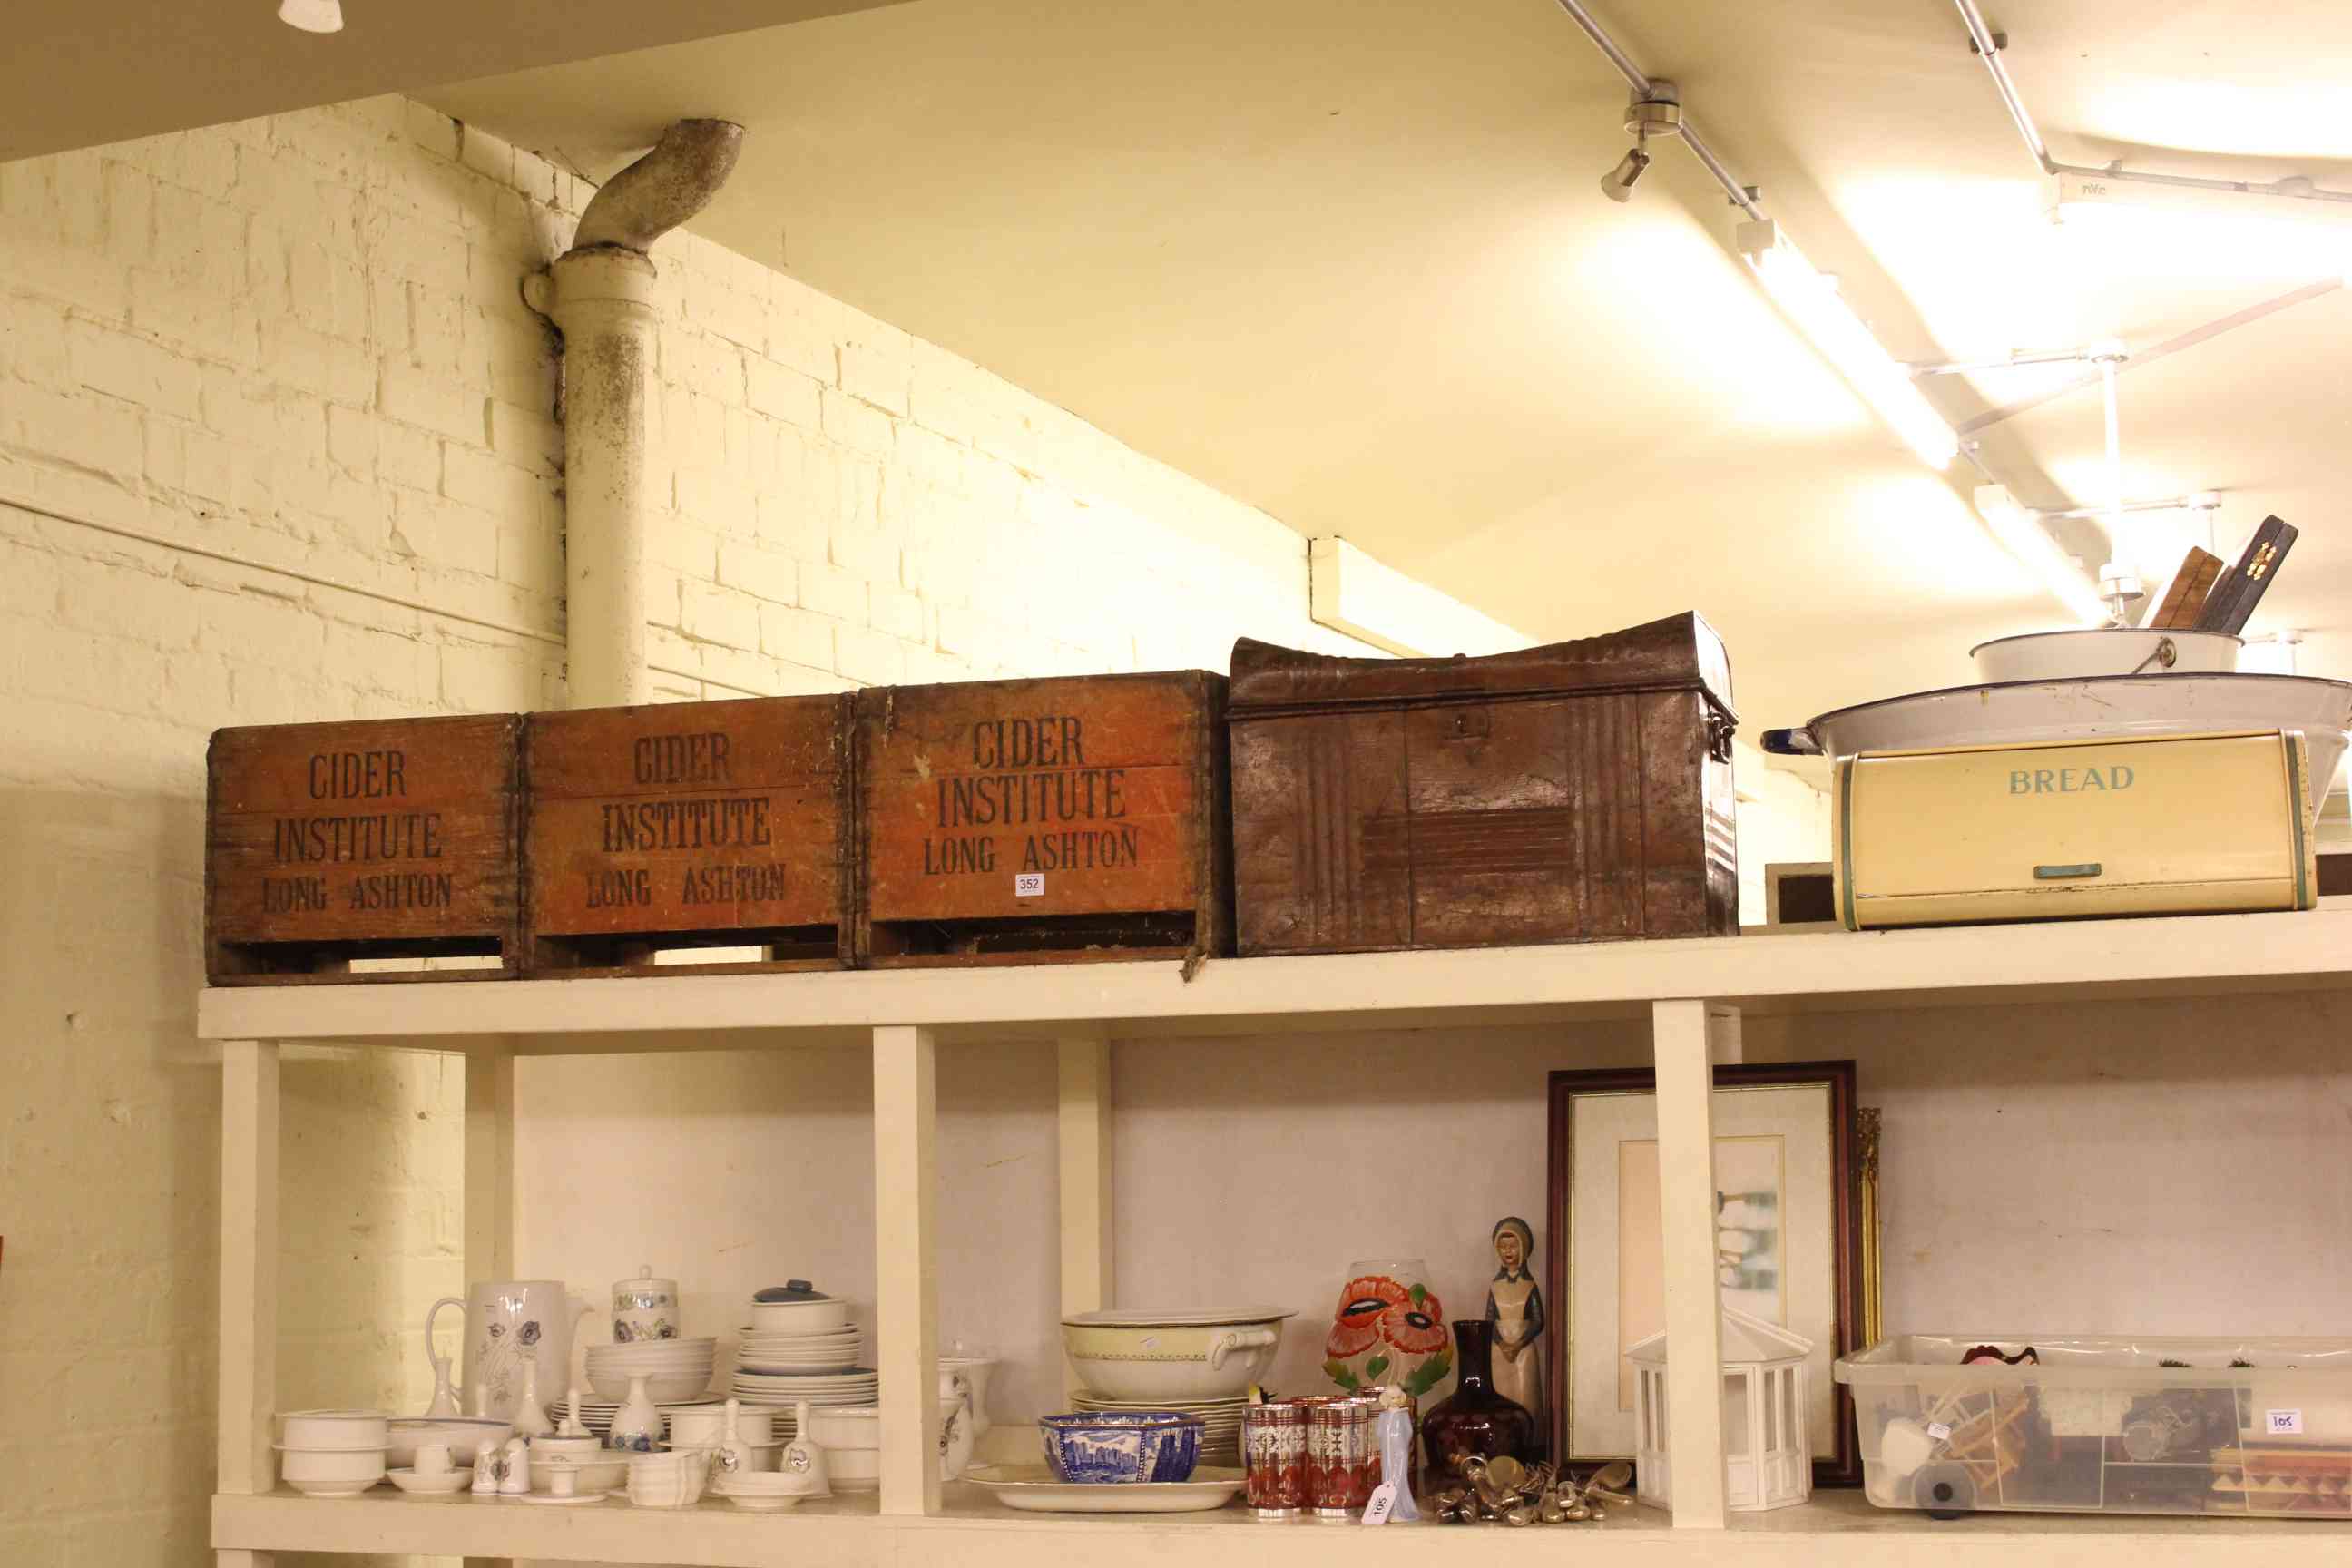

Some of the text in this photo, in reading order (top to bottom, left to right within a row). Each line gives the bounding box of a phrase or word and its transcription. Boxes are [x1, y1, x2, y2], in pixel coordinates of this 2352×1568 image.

[633, 733, 730, 784] CIDER
[972, 716, 1084, 769] CIDER
[309, 750, 407, 799] CIDER
[937, 769, 1127, 828] INSTITUTE
[2010, 766, 2134, 795] BREAD
[275, 813, 442, 862] INSTITUTE
[602, 798, 770, 852] INSTITUTE
[922, 826, 1139, 876] LONG ASHTON
[261, 872, 453, 913] LONG ASHTON
[586, 863, 787, 908] LONG ASHTON
[1020, 878, 1039, 890] 352
[2273, 1416, 2292, 1426] 105
[1374, 1497, 1387, 1515] 105
